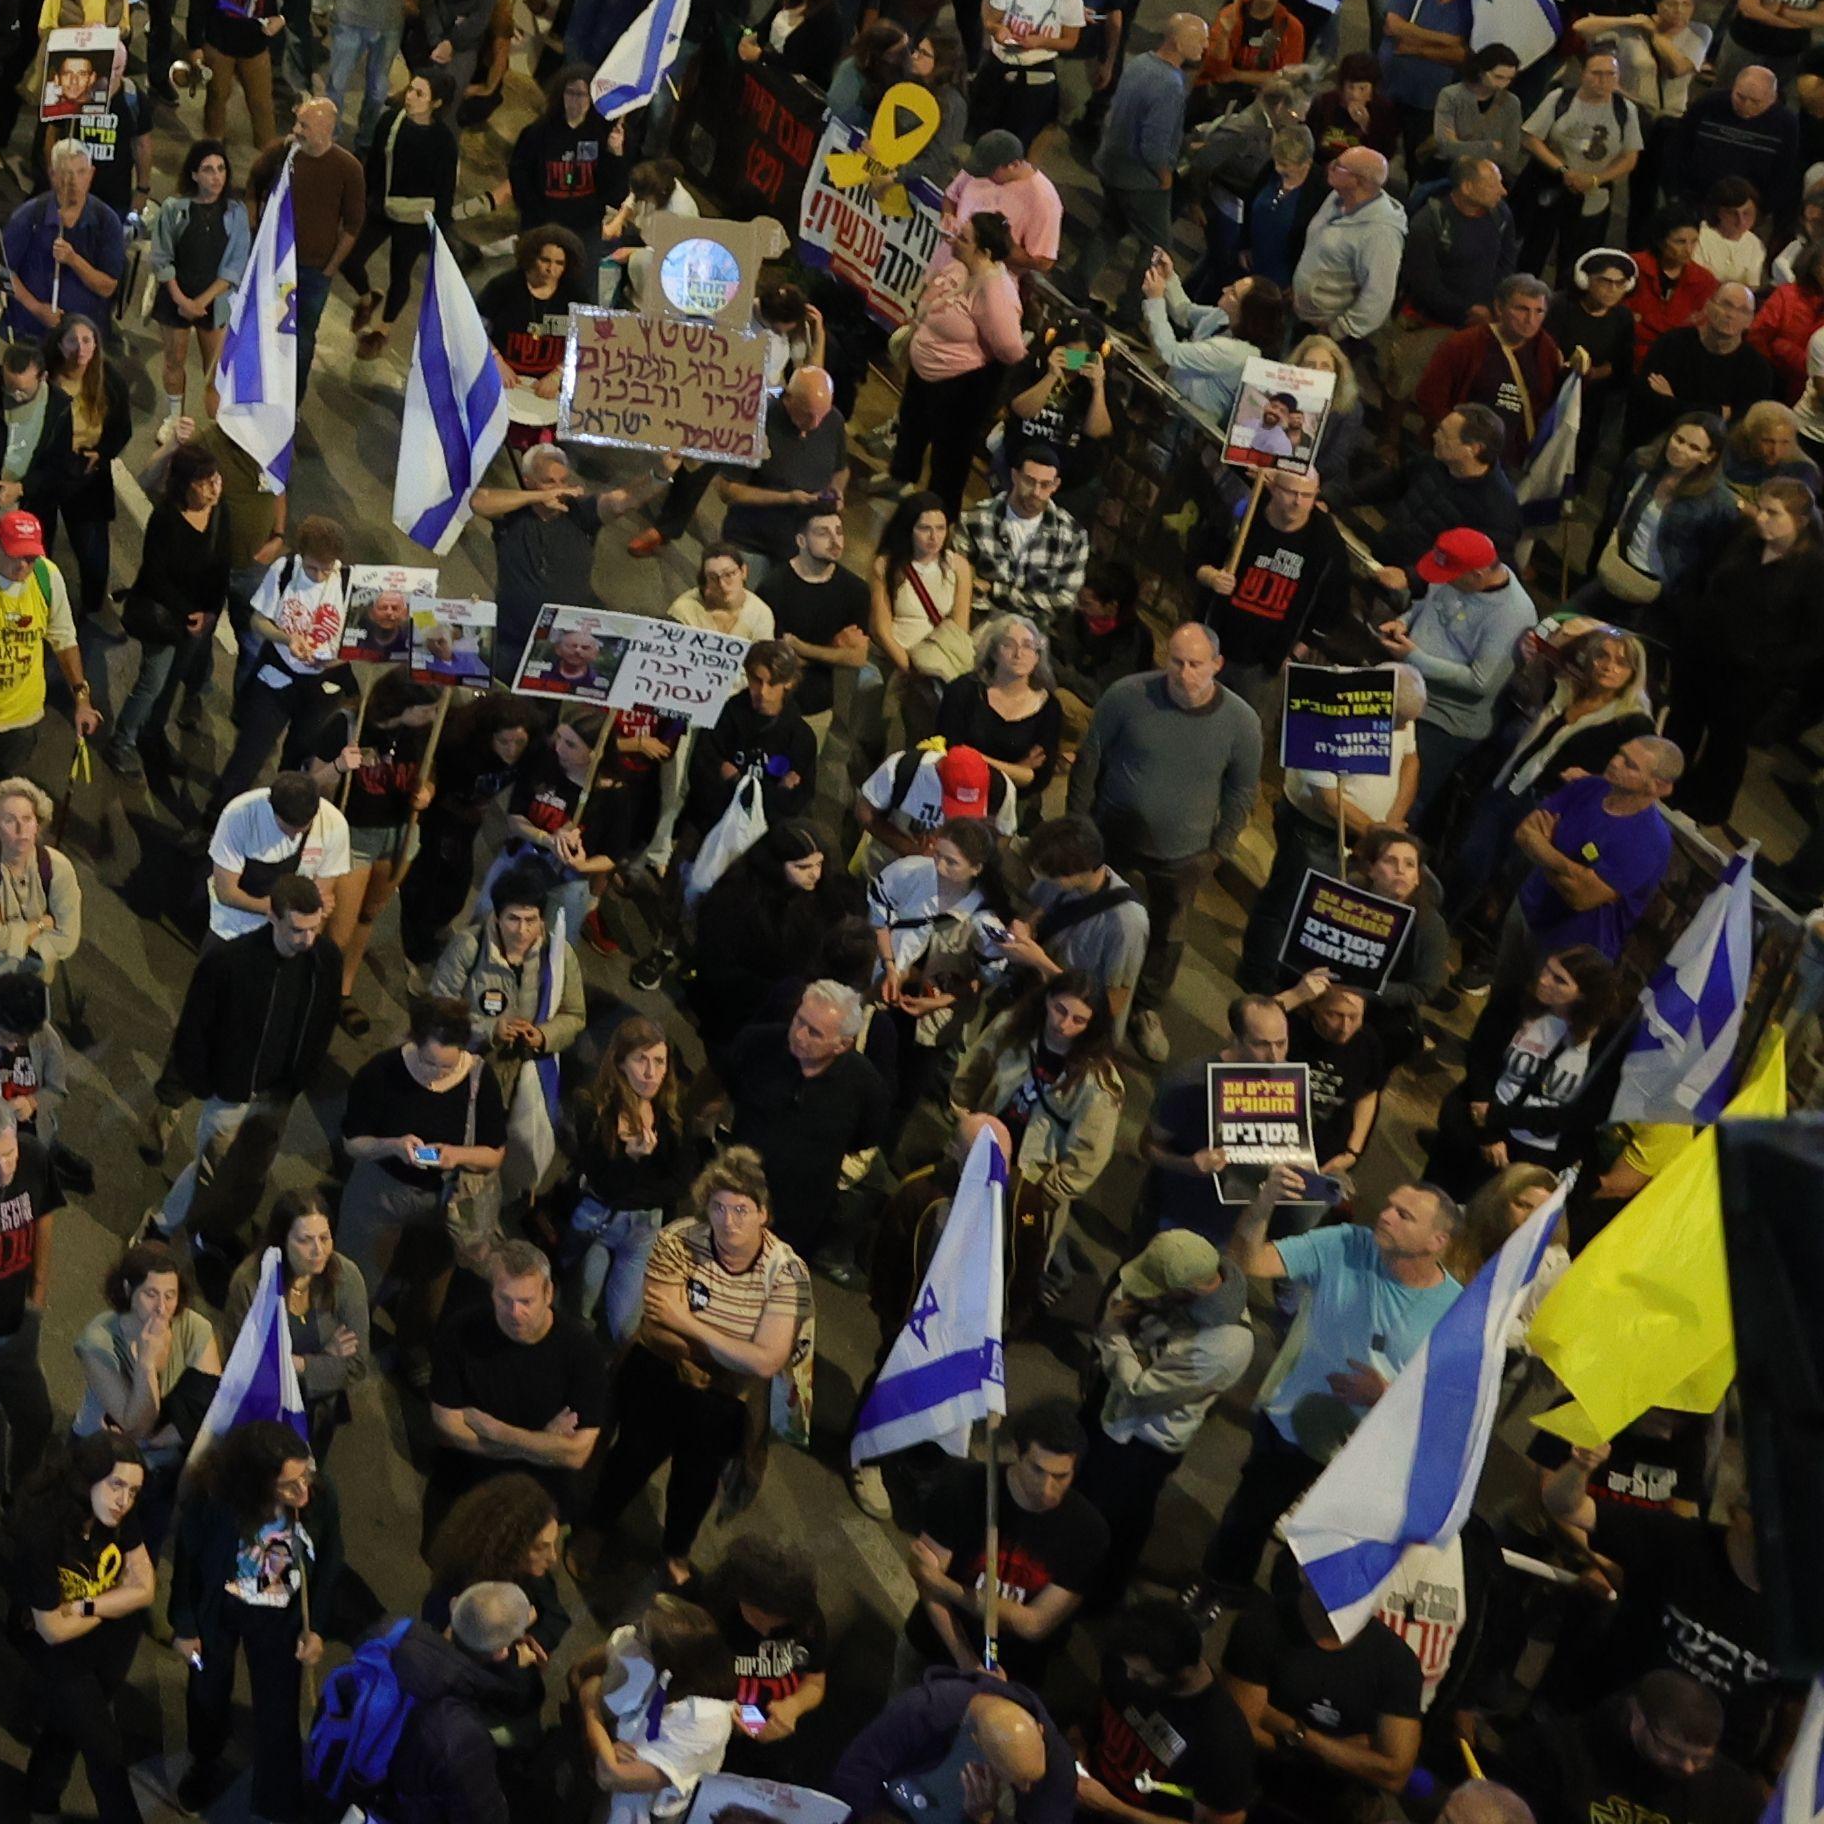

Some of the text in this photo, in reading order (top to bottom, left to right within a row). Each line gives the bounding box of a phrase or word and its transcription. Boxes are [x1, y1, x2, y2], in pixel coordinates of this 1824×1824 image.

[570, 406, 652, 436] ישראל
[648, 622, 744, 657] סבא שלי
[634, 675, 713, 704] עסקה
[1222, 1079, 1295, 1097] מצילים את
[1222, 1096, 1296, 1115] החטופים
[1221, 1121, 1300, 1145] מסרבים
